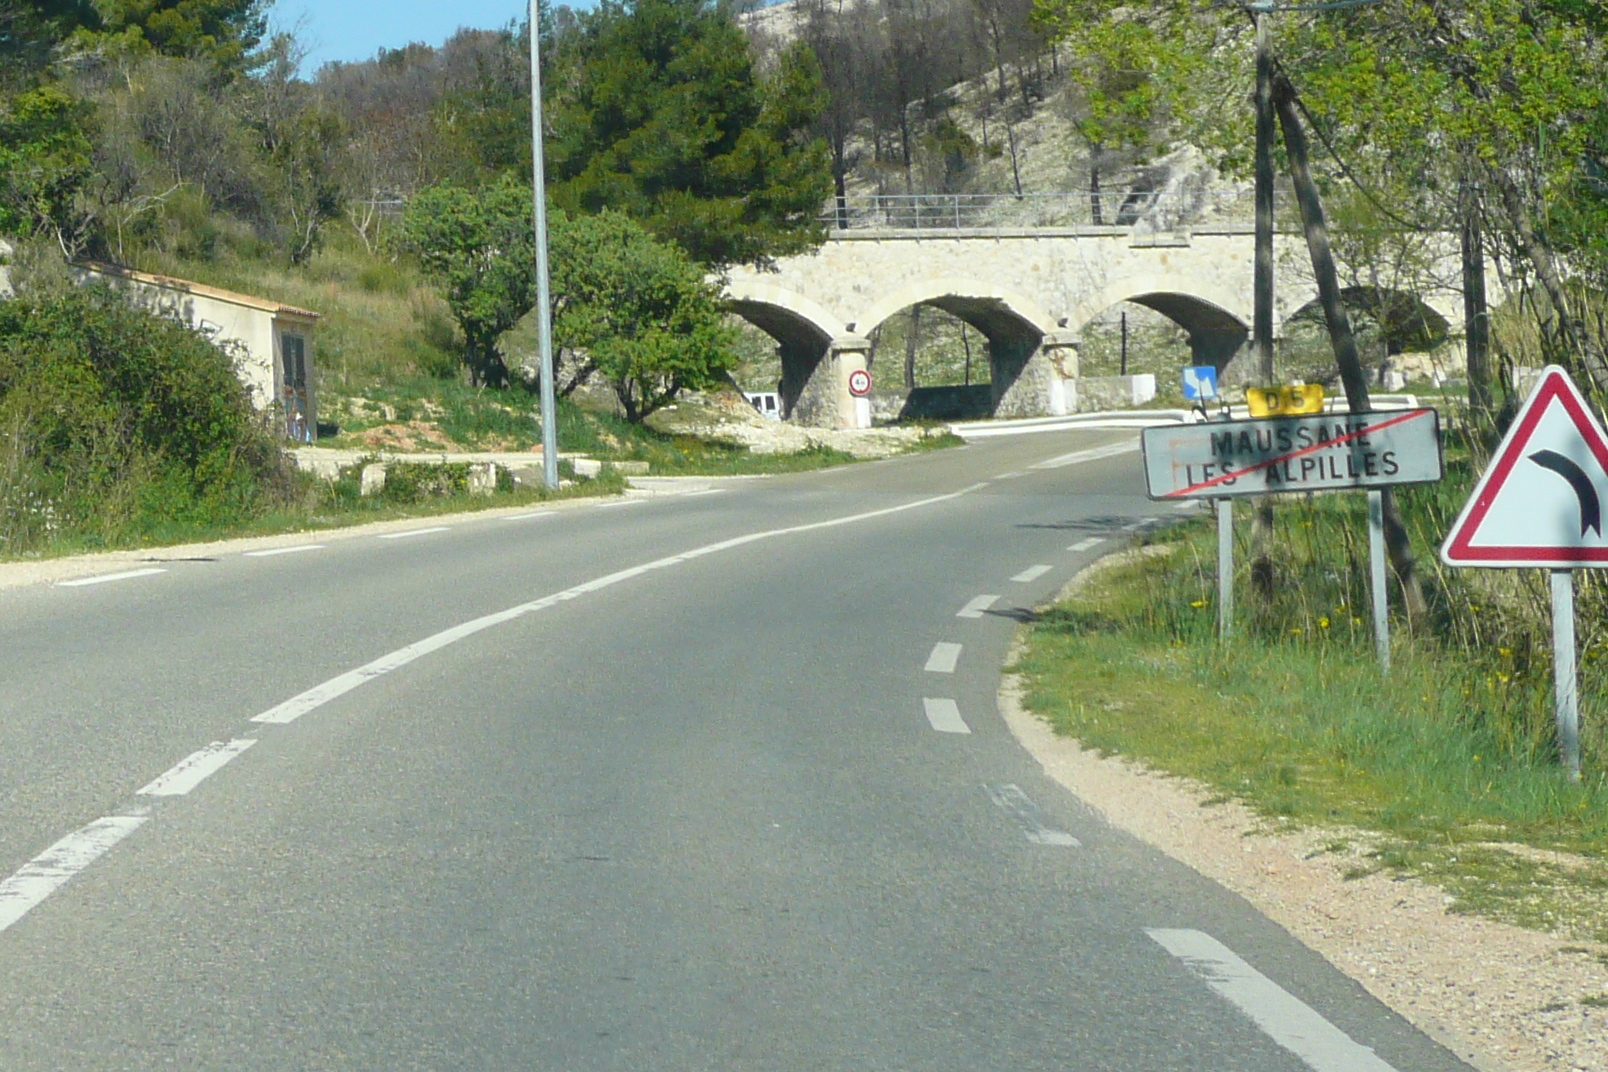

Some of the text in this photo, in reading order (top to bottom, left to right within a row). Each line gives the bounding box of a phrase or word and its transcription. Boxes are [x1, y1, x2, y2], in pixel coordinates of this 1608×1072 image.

[1265, 389, 1306, 411] D 5
[1210, 422, 1372, 456] MAUSSANE
[1186, 451, 1400, 488] LES ALPILLES
